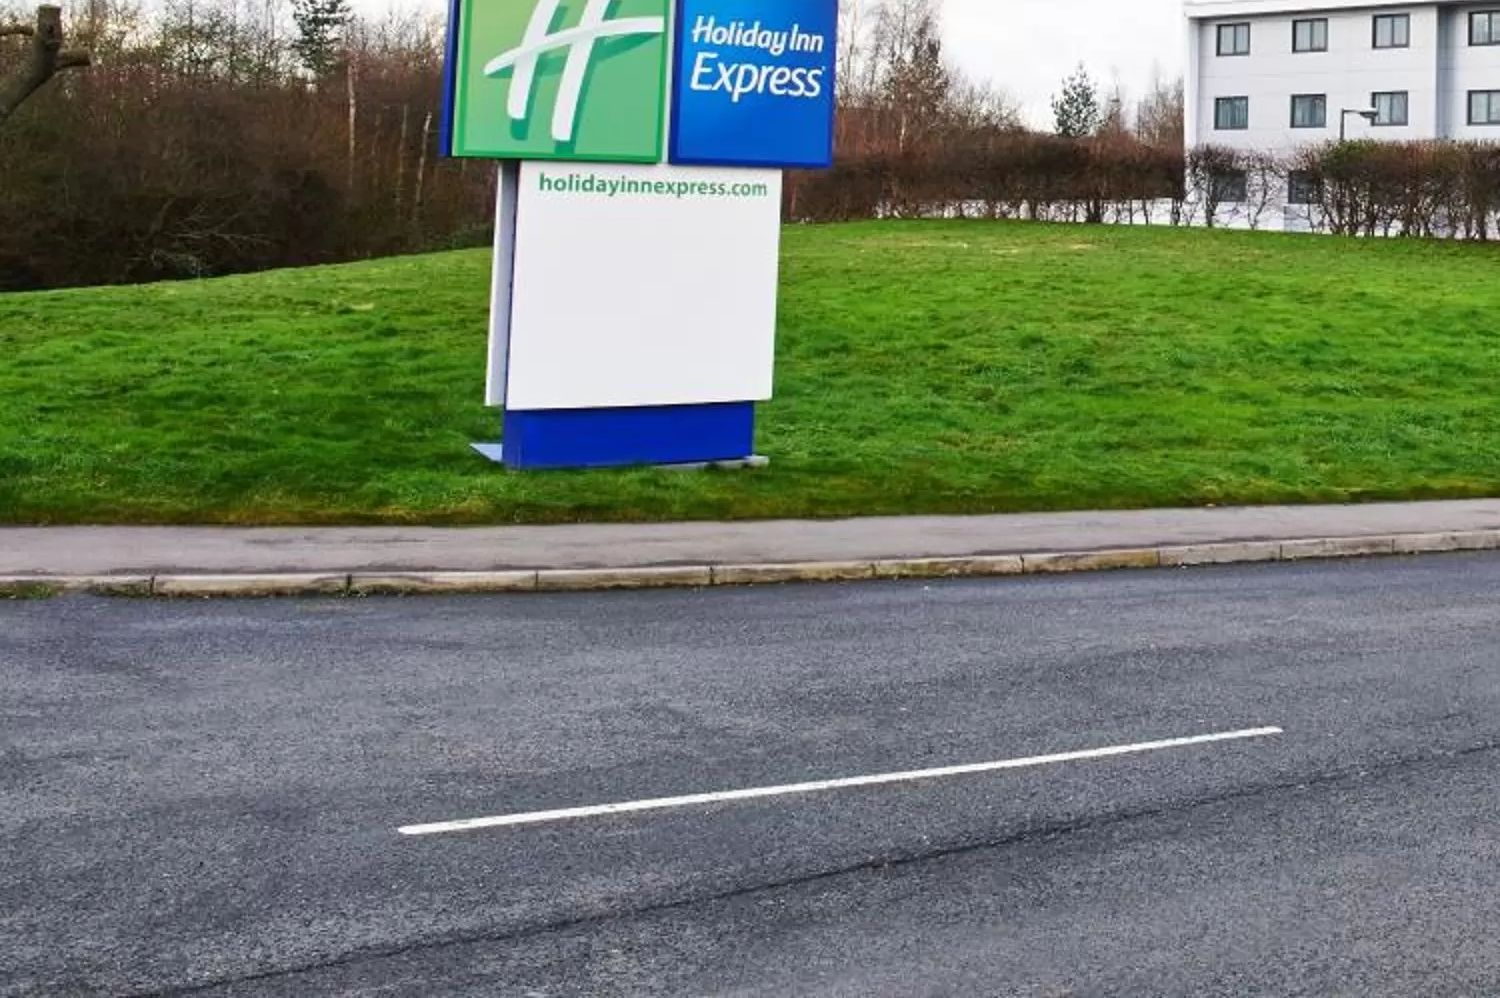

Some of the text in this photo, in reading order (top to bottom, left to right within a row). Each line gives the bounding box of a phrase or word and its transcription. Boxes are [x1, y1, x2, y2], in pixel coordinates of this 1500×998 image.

[692, 15, 824, 56] Holiday Inn
[690, 51, 824, 103] Express
[538, 173, 768, 198] holidayinnexpress.com
